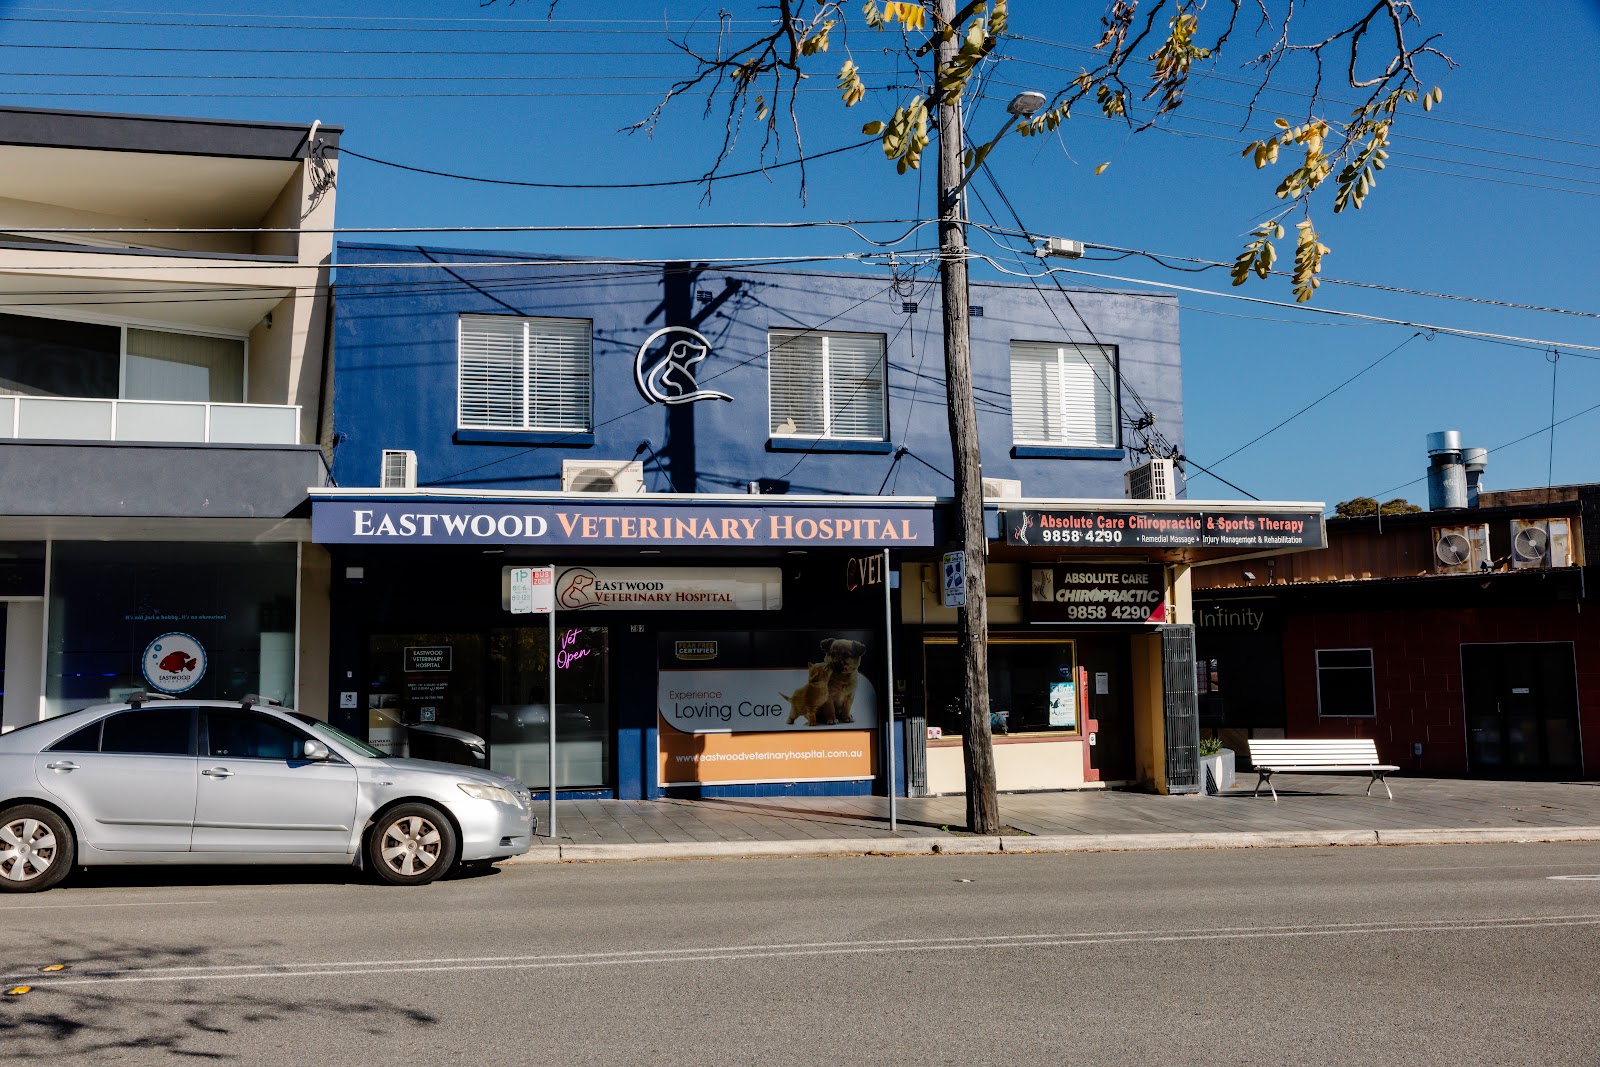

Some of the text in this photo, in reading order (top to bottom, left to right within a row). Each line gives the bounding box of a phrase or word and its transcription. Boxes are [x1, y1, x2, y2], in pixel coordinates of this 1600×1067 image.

[353, 510, 918, 540] EASTWOOD VETERINARY HOSPITAL
[1040, 514, 1304, 534] Absolute Care Chiropractic & Sports Therapy
[1043, 529, 1123, 543] 9858 4290
[1141, 535, 1195, 544] Remedial Massage
[1202, 535, 1219, 545] Injury
[1258, 535, 1263, 544] &
[1264, 535, 1303, 544] Rehabilitation
[515, 571, 528, 583] 1P
[857, 553, 884, 587] VET
[1065, 572, 1149, 584] ABSOLUTE CARE
[595, 581, 664, 591] EASTWOOD
[594, 592, 733, 603] VETERINARY HOSPITAL
[1055, 588, 1160, 603] CHIROPRACTIC
[1067, 605, 1151, 620] 9858 4290
[1199, 608, 1264, 631] Infinity
[560, 628, 583, 649] Vet
[556, 649, 591, 669] Open
[669, 690, 723, 701] Experience
[675, 701, 783, 721] Loving Care
[676, 749, 863, 763] www.eastwoodveterinaryhospital.com.au
